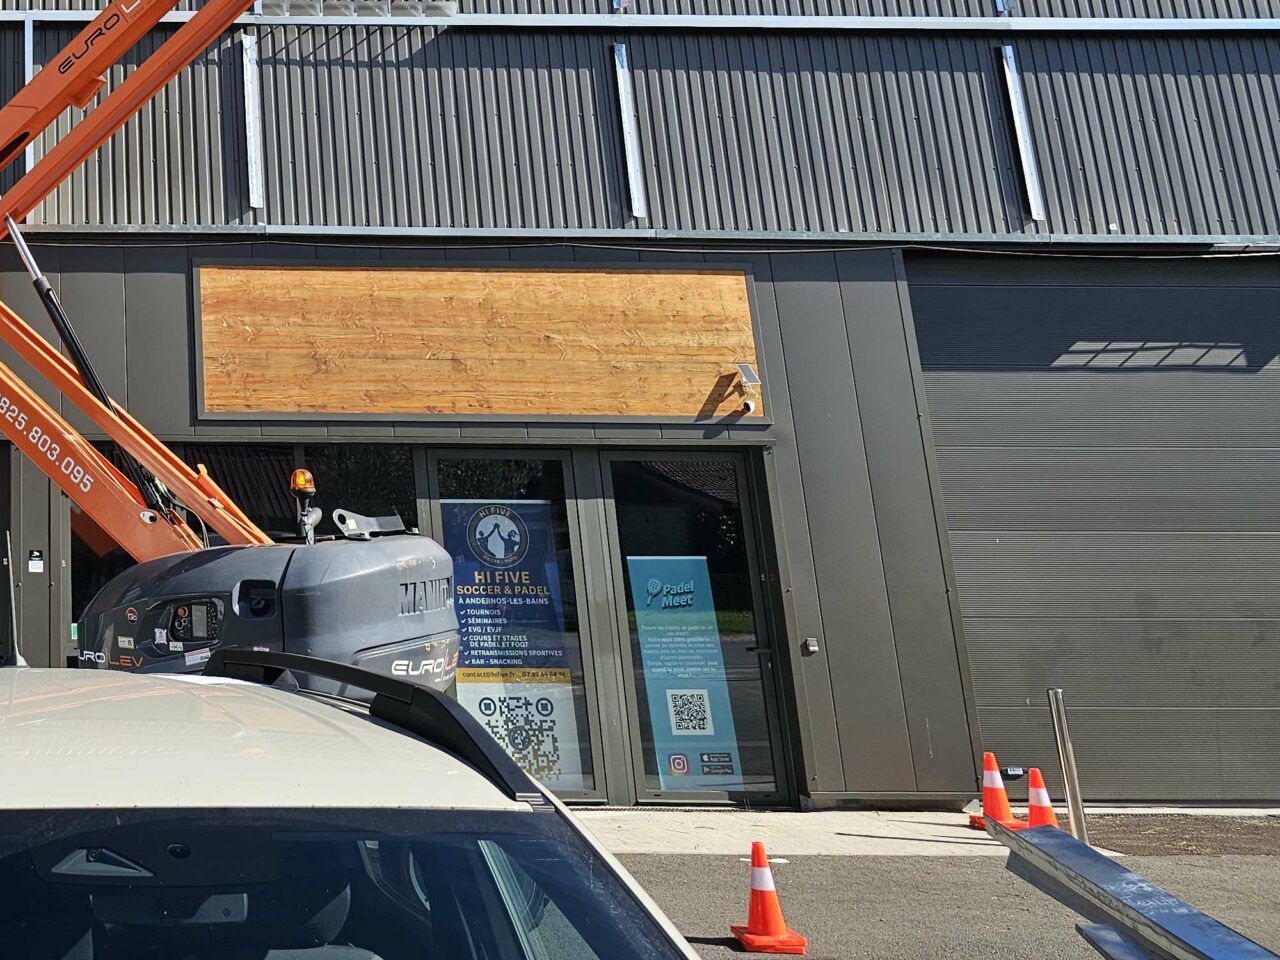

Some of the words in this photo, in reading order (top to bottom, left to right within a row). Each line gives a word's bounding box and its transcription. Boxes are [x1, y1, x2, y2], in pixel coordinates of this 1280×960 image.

[474, 571, 490, 583] HI
[495, 571, 530, 583] FIVE
[456, 585, 501, 595] SOCCER
[504, 585, 512, 595] &
[514, 585, 550, 595] PADEL
[663, 580, 695, 596] Padel
[458, 595, 464, 604] À
[465, 597, 549, 605] ANDERNOS-LES-BAINS
[662, 594, 694, 609] Meet
[467, 616, 508, 624] SÉMINAIRES
[108, 655, 143, 668] LEV
